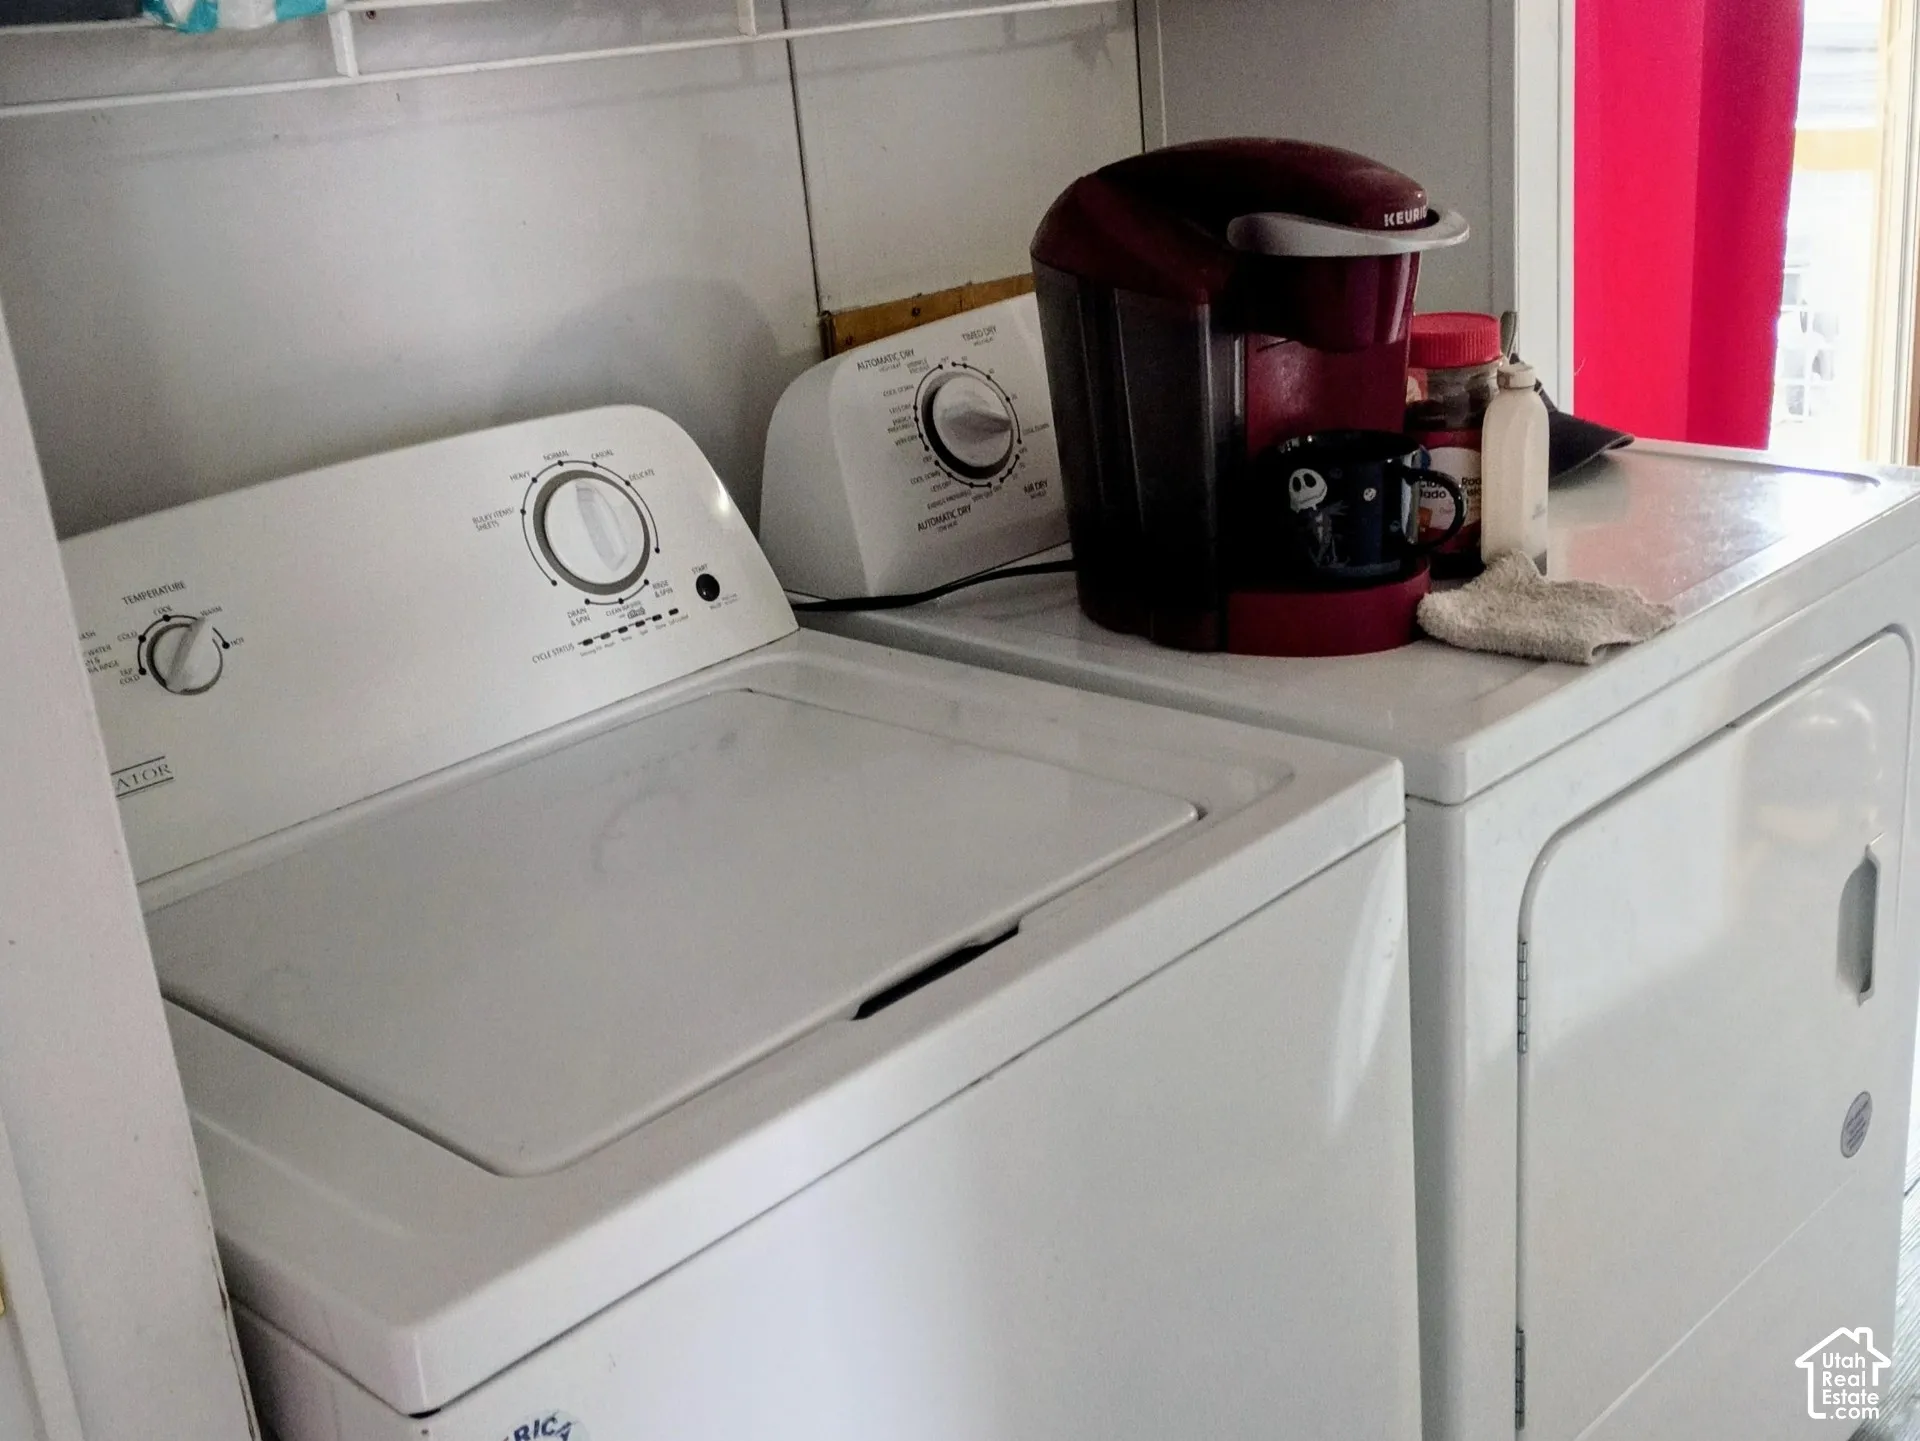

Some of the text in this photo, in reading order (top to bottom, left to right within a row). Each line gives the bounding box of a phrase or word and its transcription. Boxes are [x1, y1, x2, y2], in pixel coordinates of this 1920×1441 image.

[857, 352, 900, 371] AUTOMATIC
[543, 450, 569, 461] NORMAL
[591, 449, 614, 460] CASUAL
[509, 471, 530, 481] HEAVY
[628, 468, 655, 482] DELICATE
[472, 512, 493, 525] BULKY
[918, 504, 971, 531] AUTOMATIC DRY
[475, 520, 499, 532] SHEETS
[691, 563, 708, 574] START
[121, 581, 186, 605] TEMPERATURE
[200, 606, 223, 617] WARM
[567, 607, 587, 619] DRAIN
[605, 605, 622, 617] CLEAN
[576, 615, 591, 626] SPIN
[116, 631, 138, 642] COLD
[230, 637, 245, 648] HOT
[532, 643, 575, 664] CYCLE STATUS
[120, 675, 140, 685] COLD
[116, 763, 173, 791] ATOR
